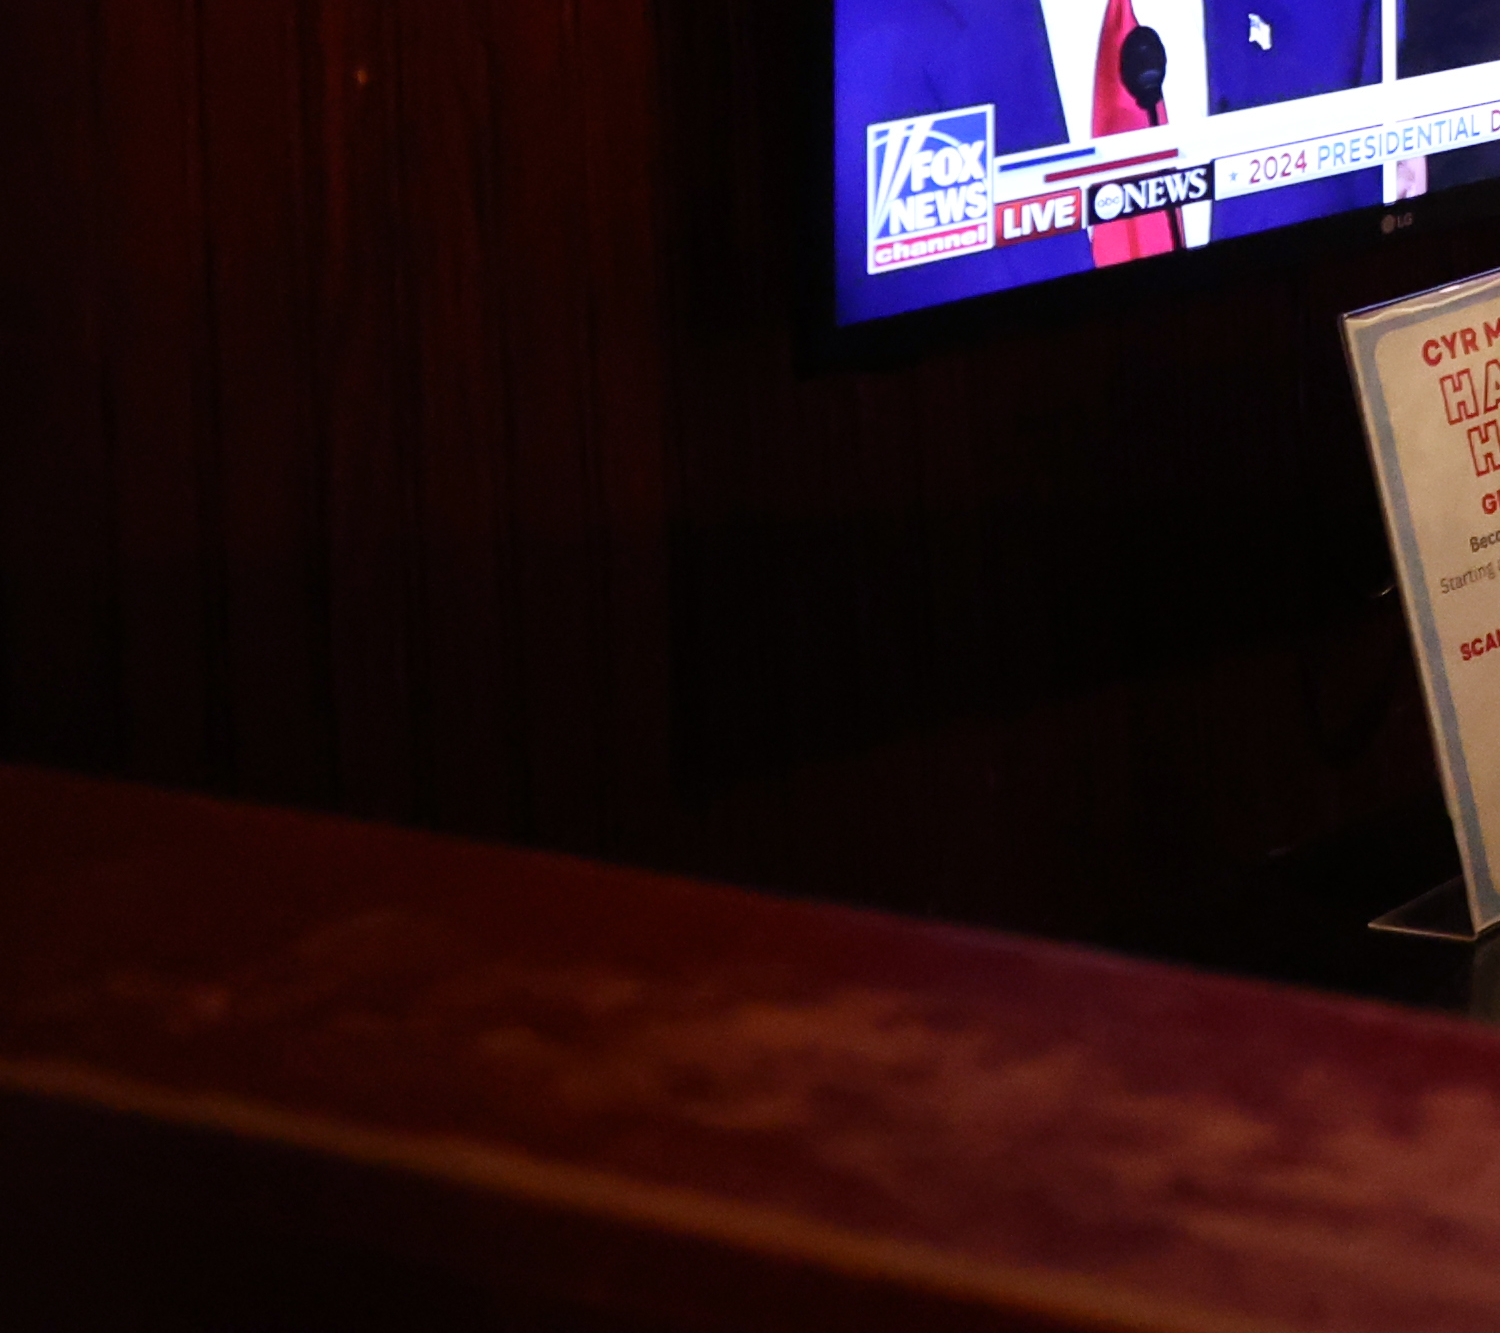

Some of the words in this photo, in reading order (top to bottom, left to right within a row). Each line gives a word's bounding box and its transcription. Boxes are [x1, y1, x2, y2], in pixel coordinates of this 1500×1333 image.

[911, 140, 986, 193] FOX
[1248, 149, 1308, 185] 2024
[1317, 115, 1481, 171] PRESIDENTIAL
[888, 182, 988, 235] NEWS
[1003, 195, 1076, 240] LIVE
[1122, 168, 1208, 214] NEWS
[875, 225, 987, 264] channel
[1421, 327, 1479, 367] CYR
[1440, 561, 1498, 595] Starting
